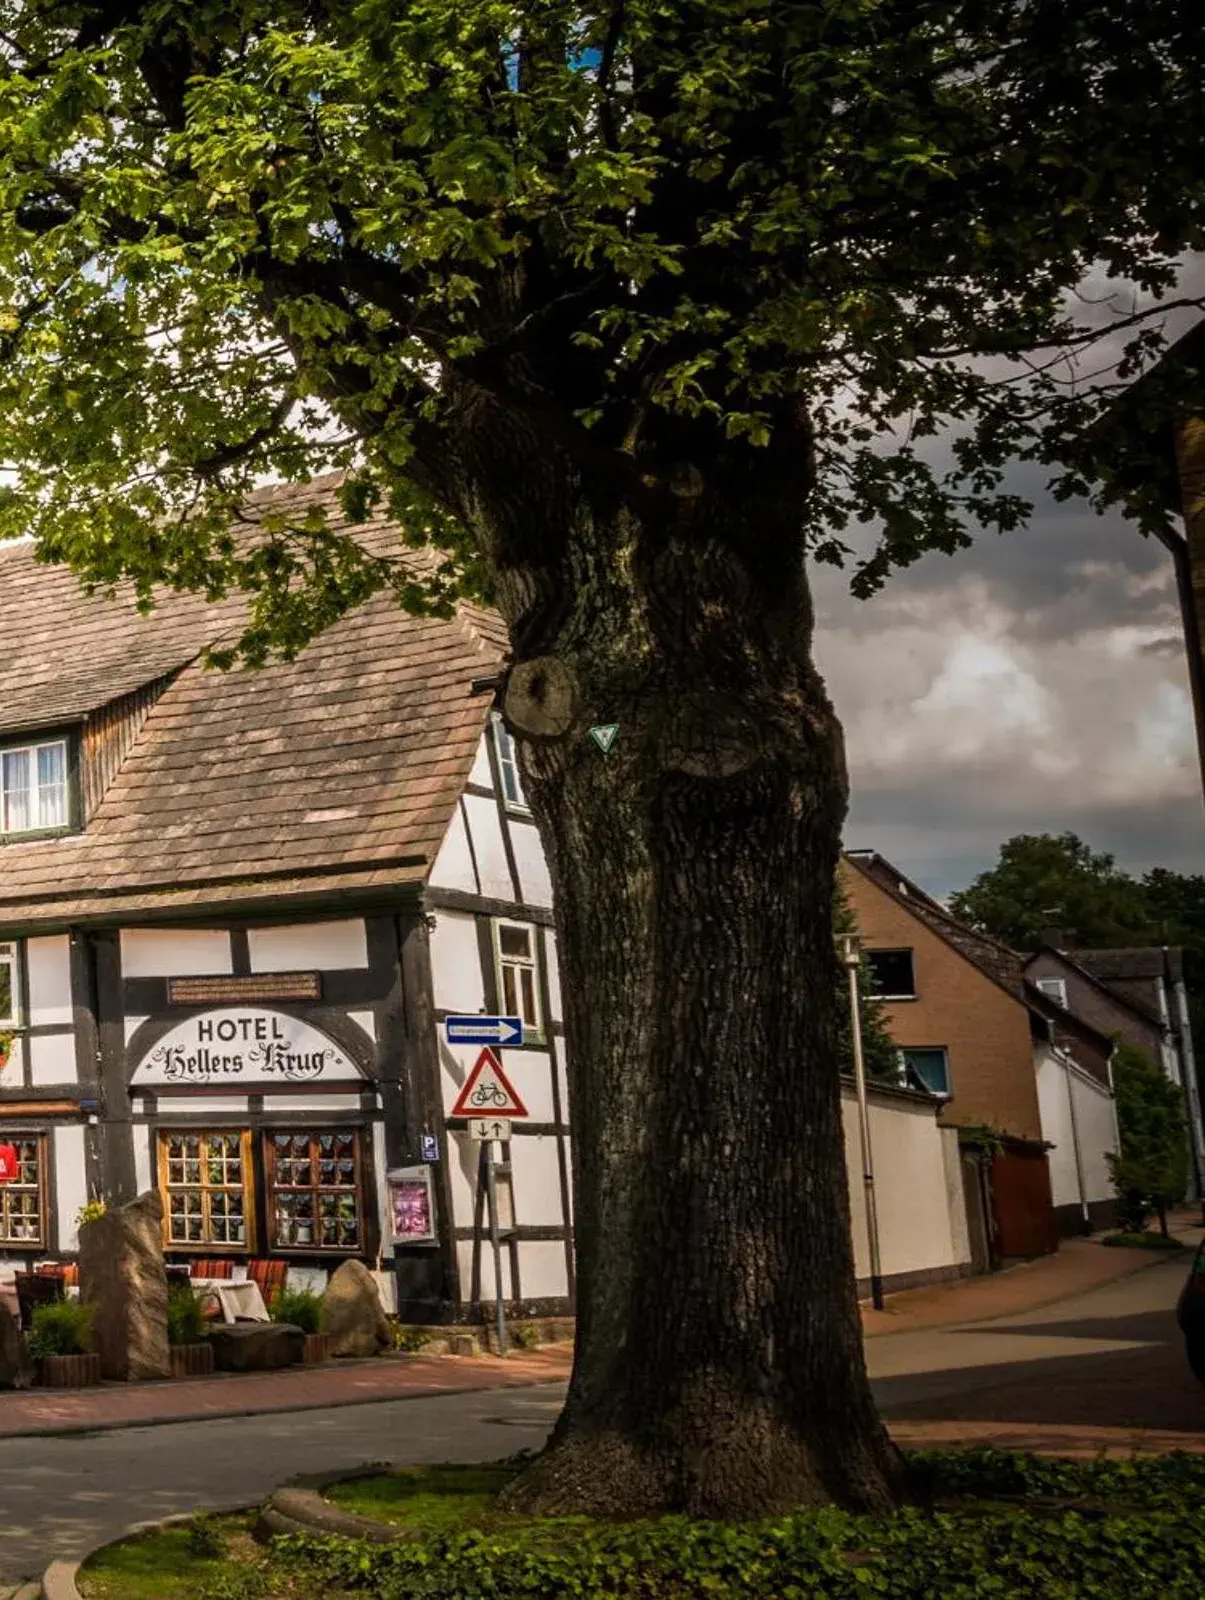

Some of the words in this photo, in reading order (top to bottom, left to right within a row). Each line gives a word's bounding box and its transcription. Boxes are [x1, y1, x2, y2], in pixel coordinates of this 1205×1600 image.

[198, 1017, 283, 1042] HOTEL
[152, 1044, 244, 1081] Hellers
[249, 1041, 335, 1080] Krug
[425, 1136, 434, 1148] P
